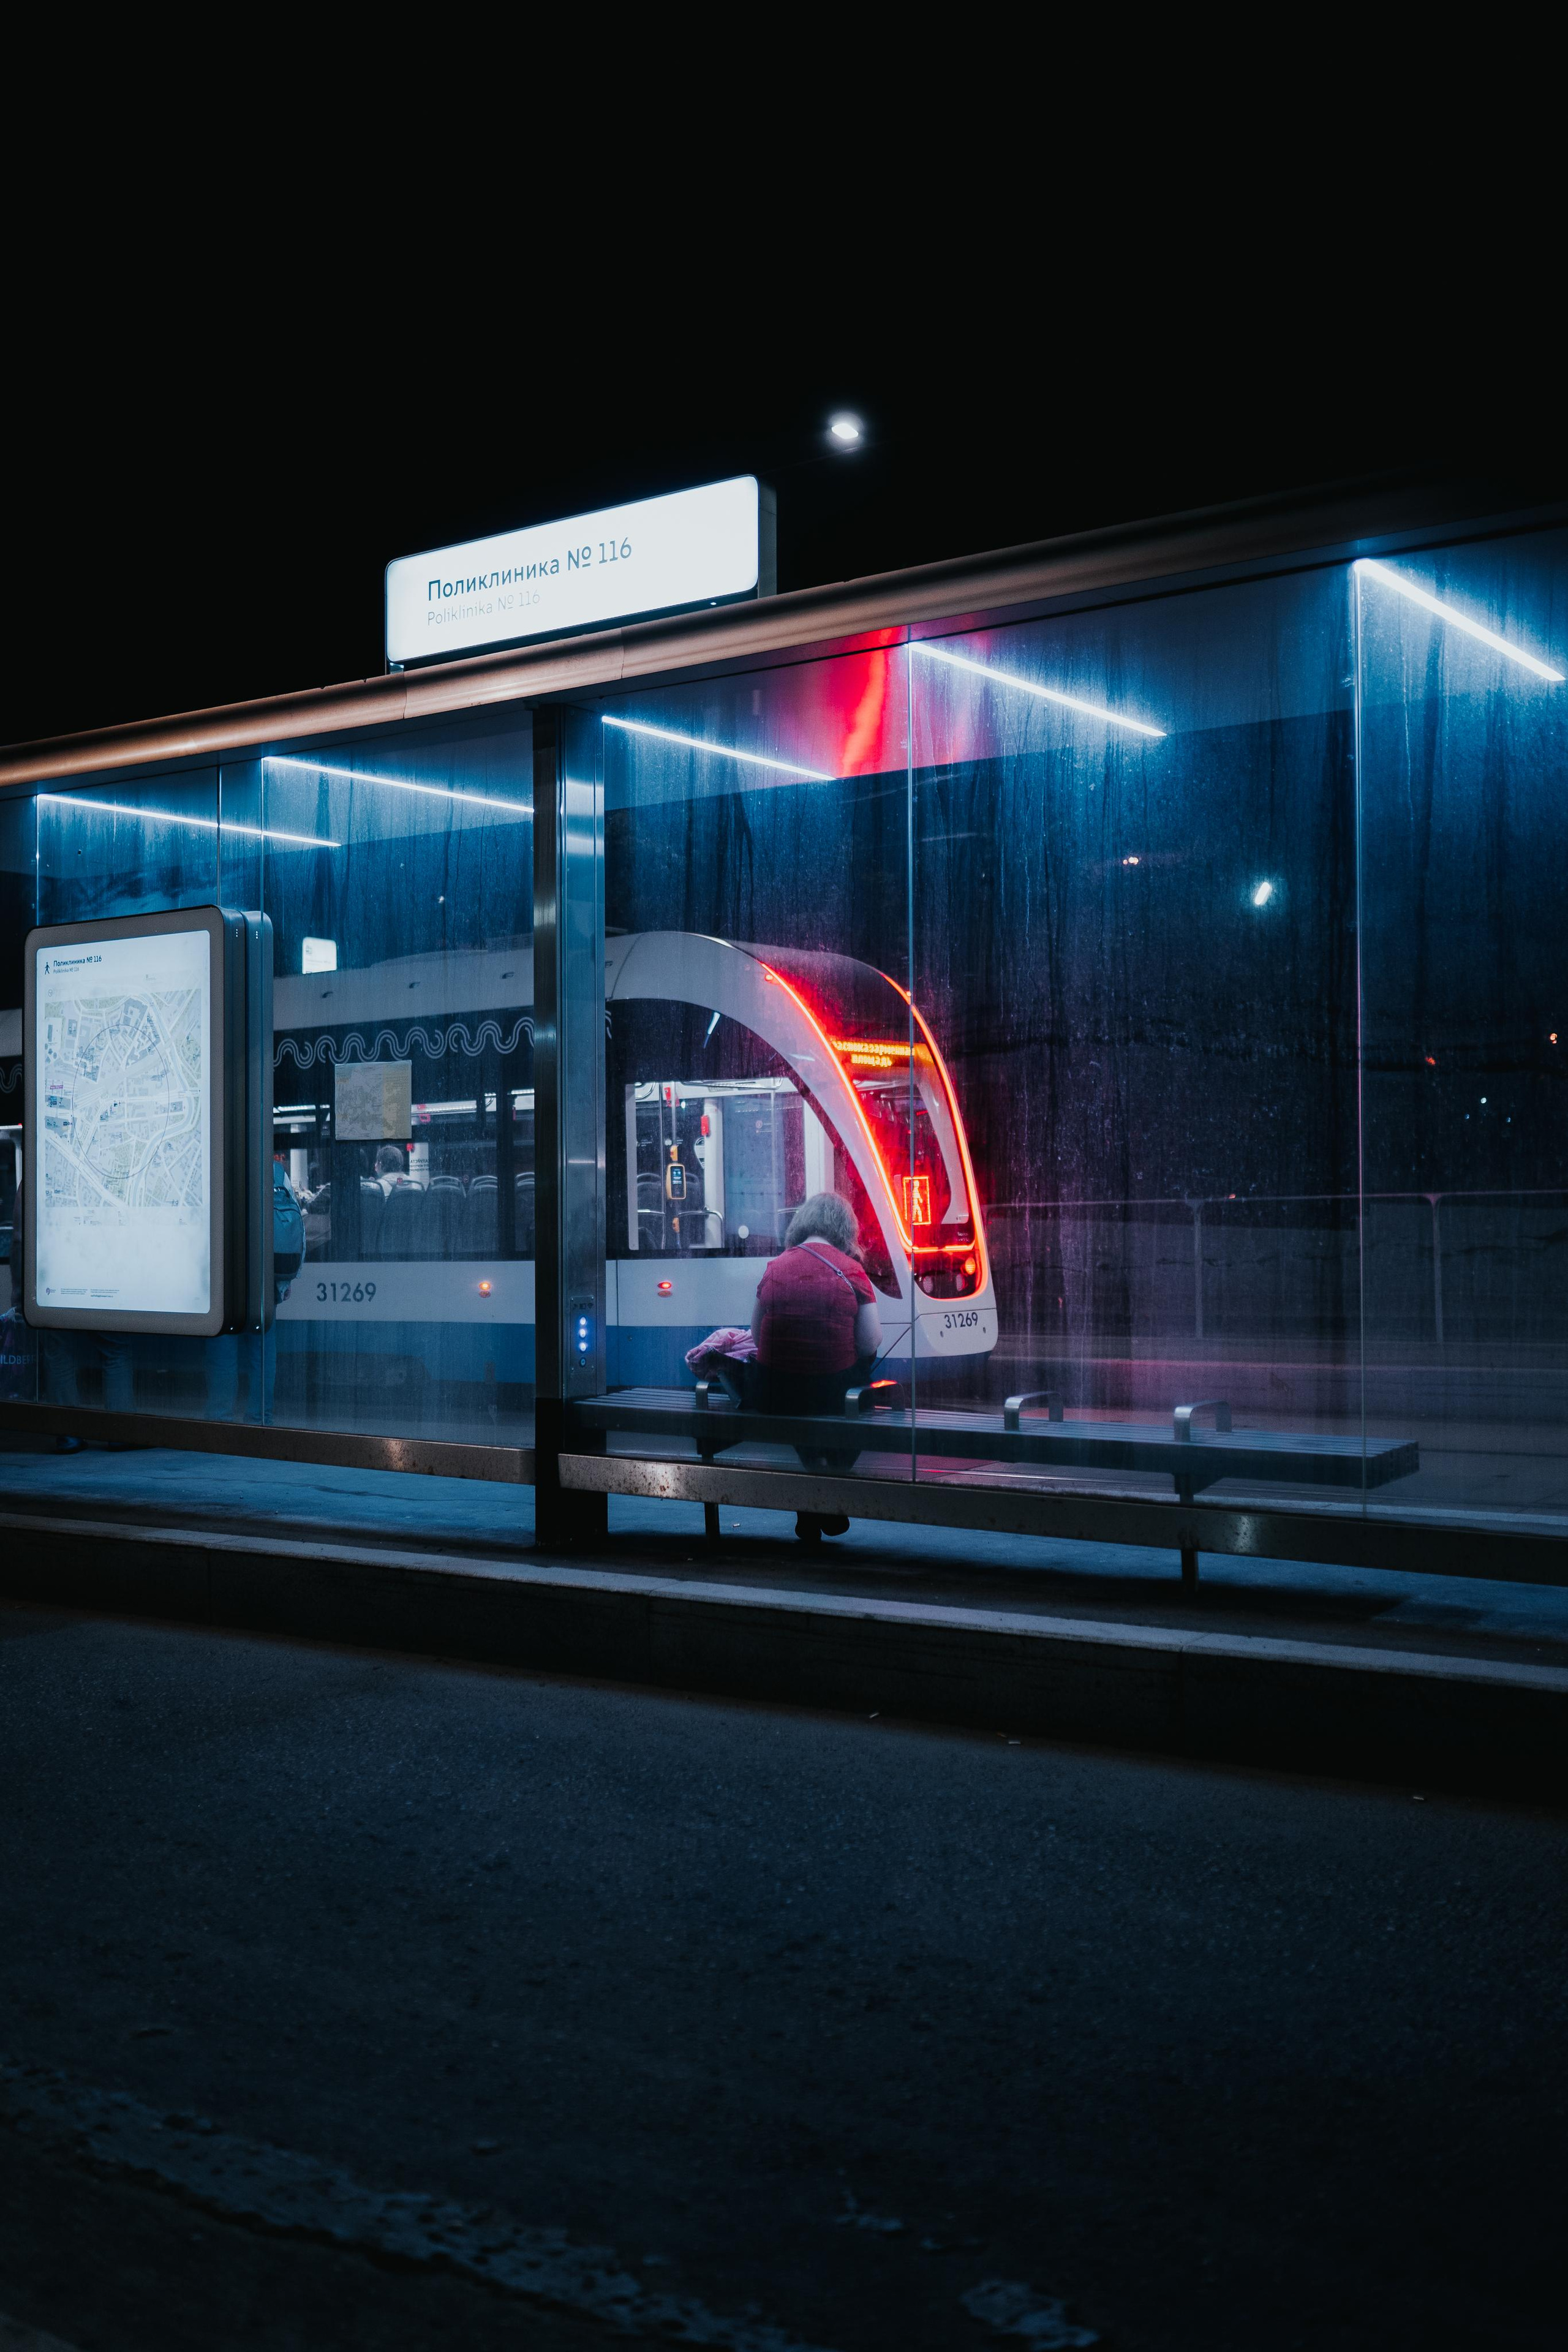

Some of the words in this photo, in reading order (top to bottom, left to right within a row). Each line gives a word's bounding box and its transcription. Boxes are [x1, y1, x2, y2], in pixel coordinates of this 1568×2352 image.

[428, 558, 560, 601] Поликлиника
[568, 546, 592, 571] №
[598, 537, 632, 564] 116
[428, 600, 493, 626] Poliklinika
[498, 594, 514, 611] №
[519, 589, 540, 607] 116
[53, 959, 86, 967] Поликлиника
[317, 1282, 377, 1303] 31269
[944, 1311, 978, 1329] 31269
